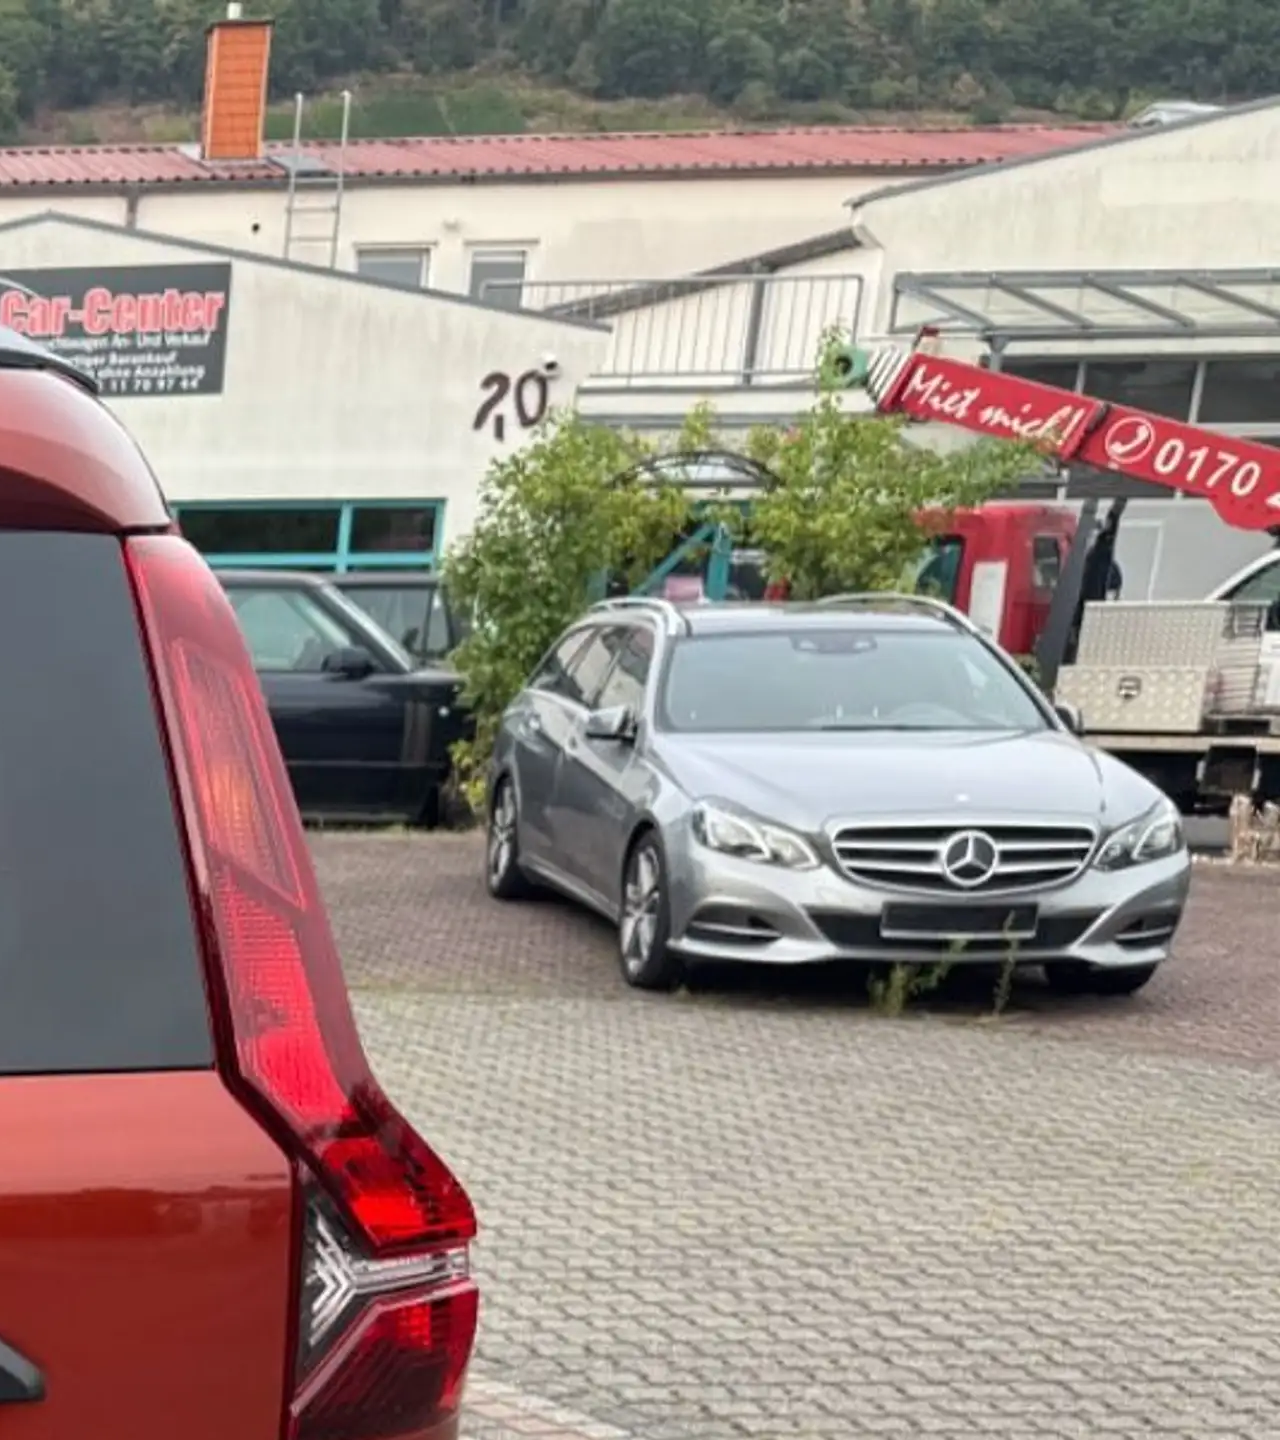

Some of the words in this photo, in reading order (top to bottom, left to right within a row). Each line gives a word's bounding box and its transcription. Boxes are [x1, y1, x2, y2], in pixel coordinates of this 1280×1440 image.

[0, 286, 224, 335] Car-Center
[135, 363, 206, 380] Anzahlung
[901, 366, 981, 418] Miet
[472, 369, 548, 442] 20
[1153, 439, 1262, 497] 0170
